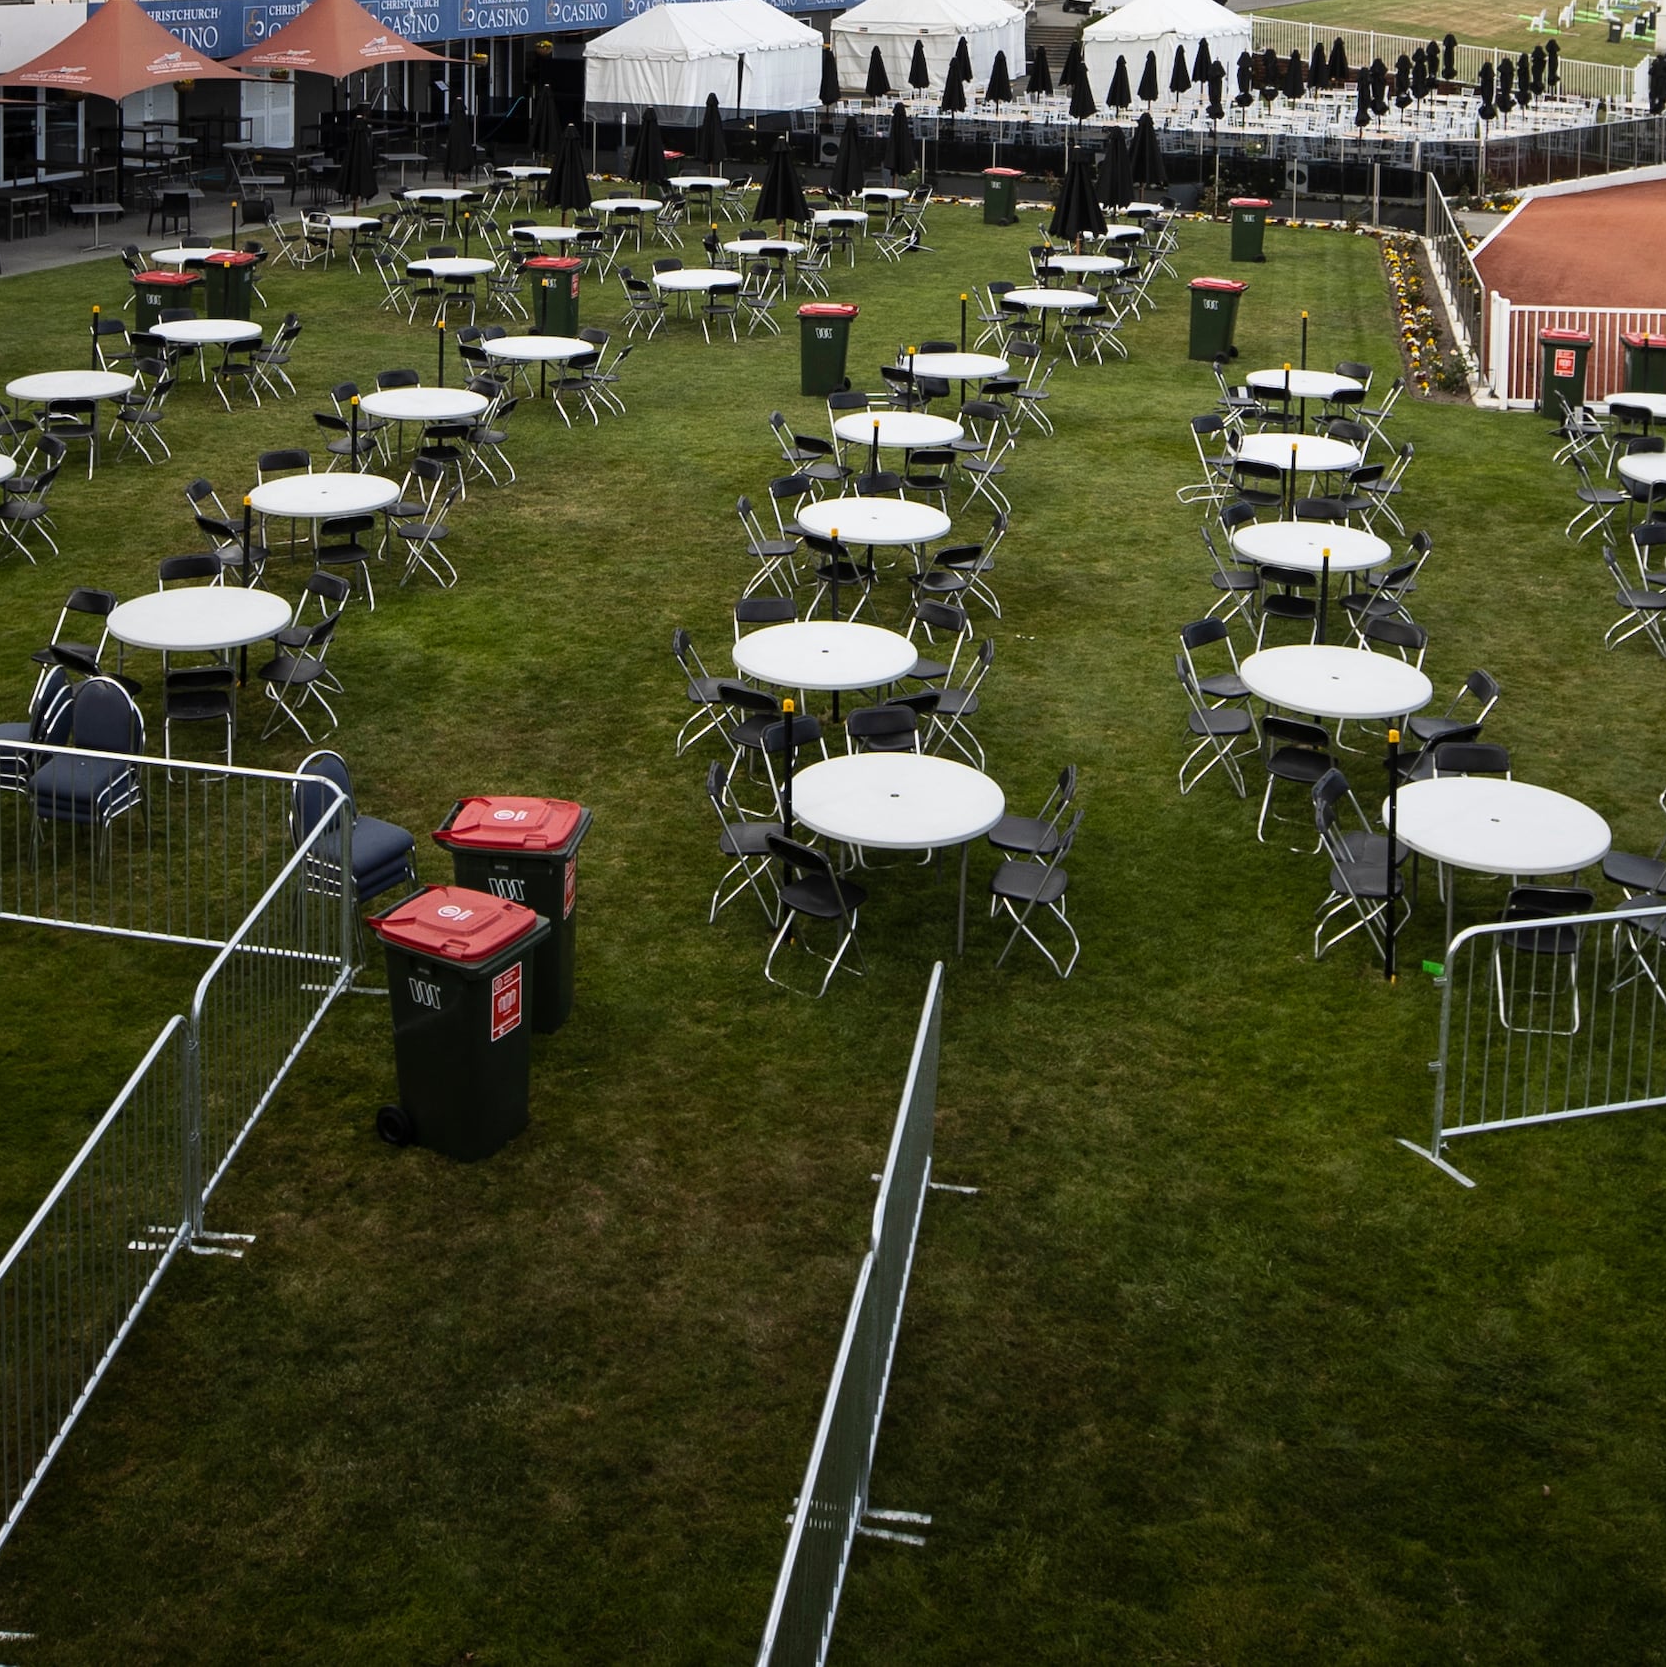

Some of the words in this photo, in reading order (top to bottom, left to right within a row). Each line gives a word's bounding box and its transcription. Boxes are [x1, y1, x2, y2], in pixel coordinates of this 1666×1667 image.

[146, 7, 219, 22] HRISTCHURCH
[477, 7, 529, 30] CASINO
[561, 2, 608, 23] CASINO
